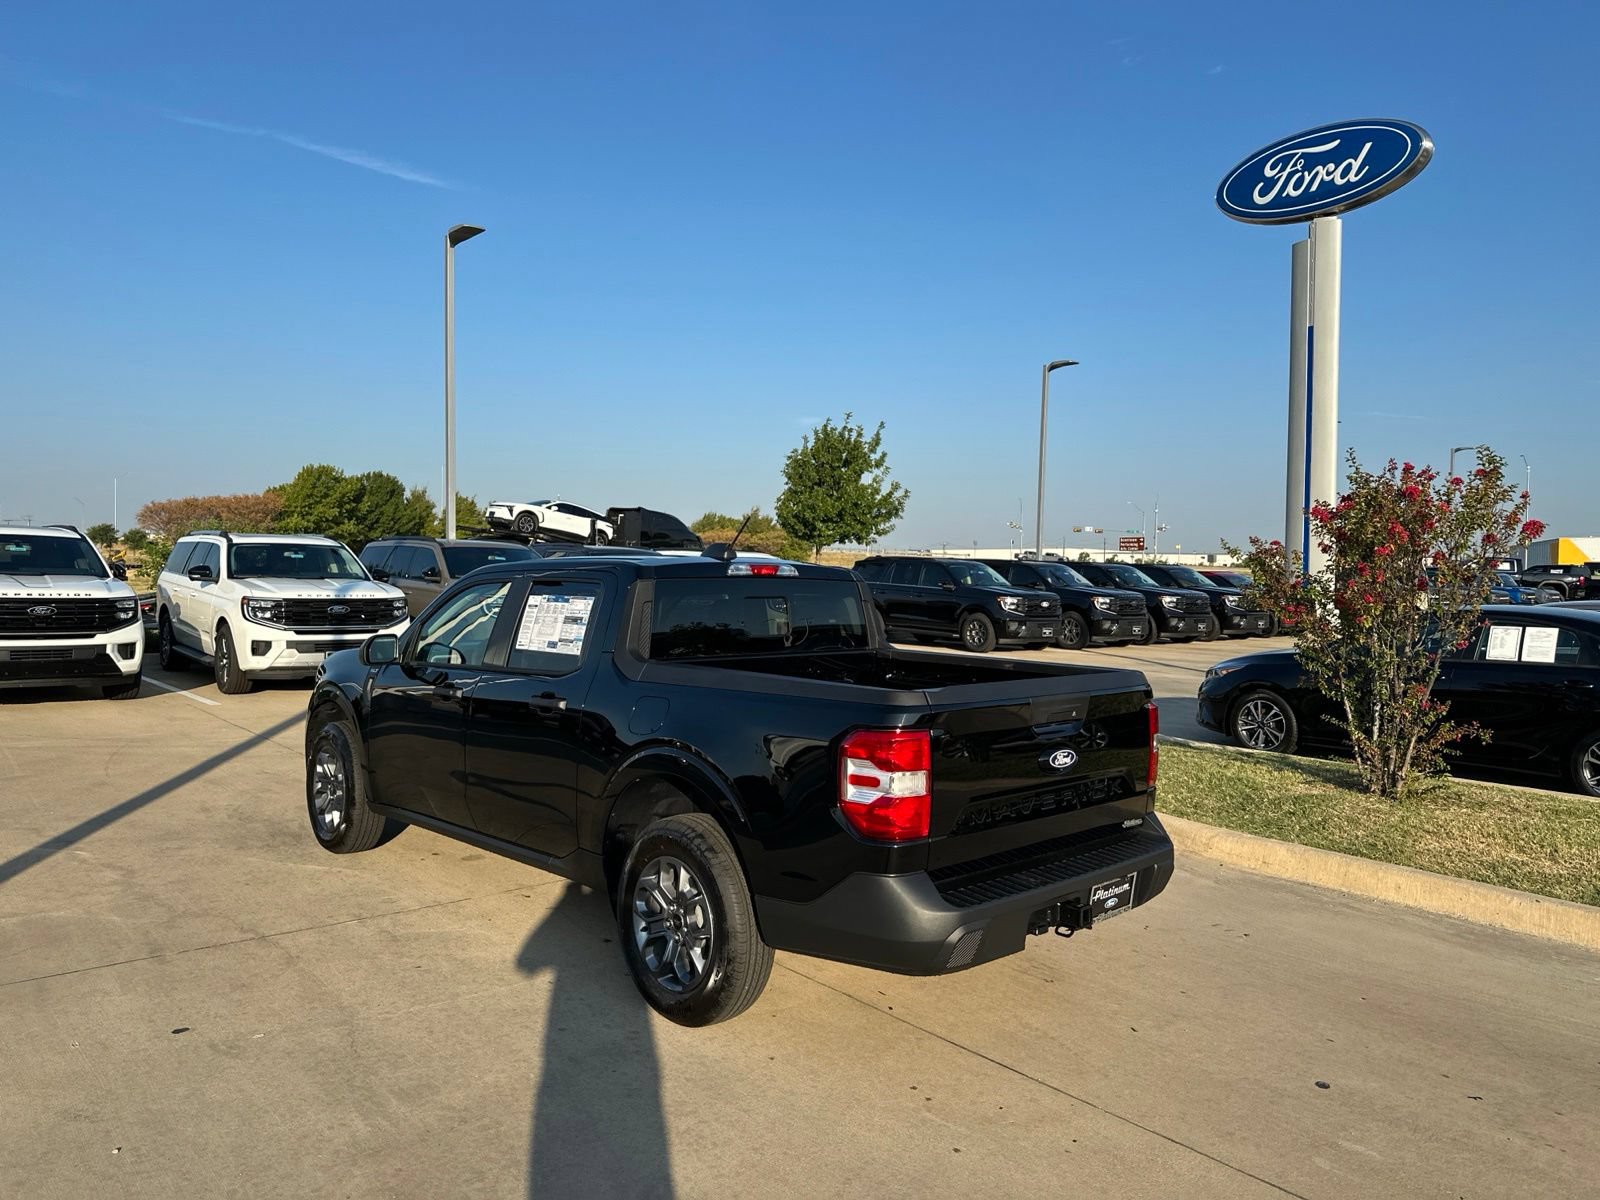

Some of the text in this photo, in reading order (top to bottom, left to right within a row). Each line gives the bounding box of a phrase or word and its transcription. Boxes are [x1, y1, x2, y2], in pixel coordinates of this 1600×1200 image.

[1253, 139, 1373, 205] Ford
[1054, 752, 1073, 767] Ford
[969, 777, 1124, 826] MAVERICK
[1092, 882, 1131, 902] Platinum
